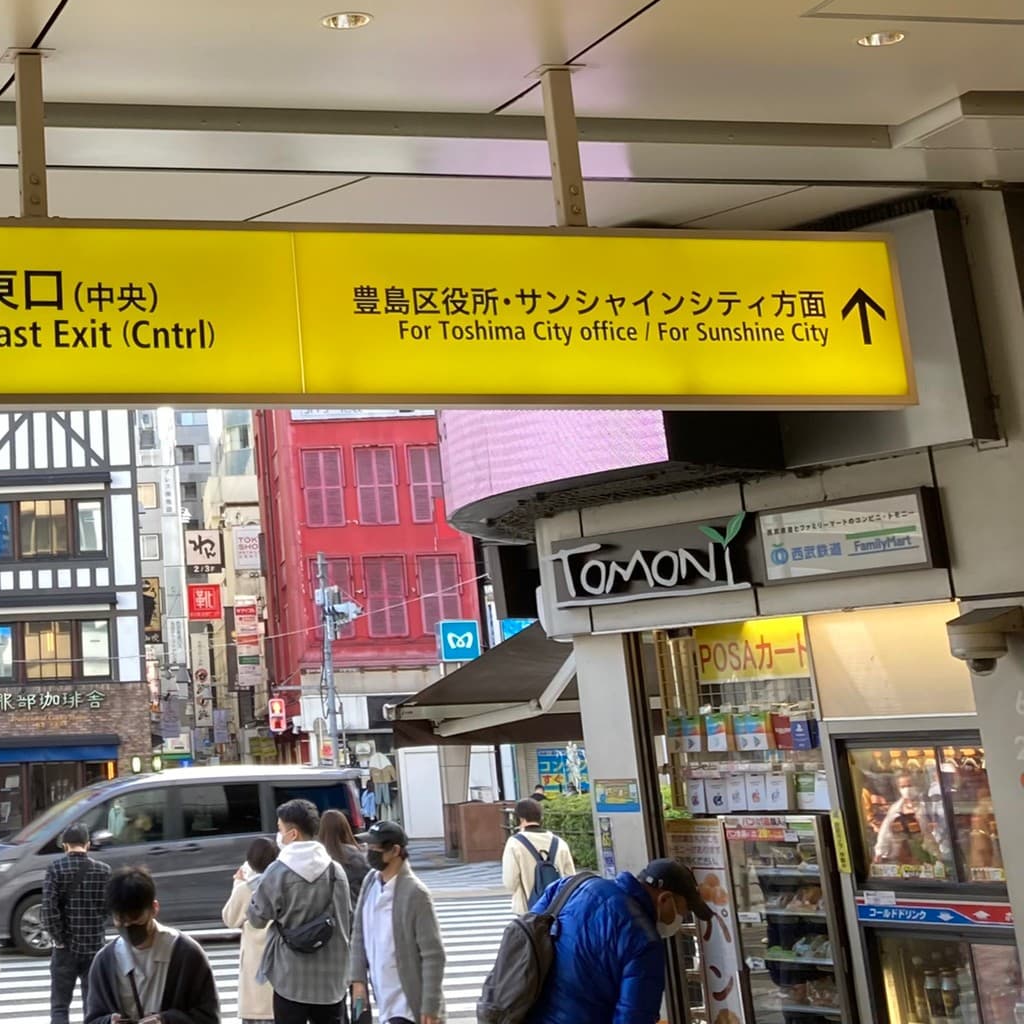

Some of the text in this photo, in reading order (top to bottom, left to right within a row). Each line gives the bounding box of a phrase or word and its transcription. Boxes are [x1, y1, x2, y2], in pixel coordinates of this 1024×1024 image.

[54, 318, 112, 349] Exit
[122, 319, 215, 349] (Cntrl)
[398, 320, 431, 340] For
[438, 320, 526, 341] Toshima
[533, 321, 572, 346] City
[580, 320, 637, 341] office
[658, 322, 689, 341] For
[696, 321, 785, 342] Sunshine
[791, 322, 829, 347] City
[791, 535, 913, 561] 西武鉄道 FamilyMart
[869, 908, 927, 920] コールドドリンク
